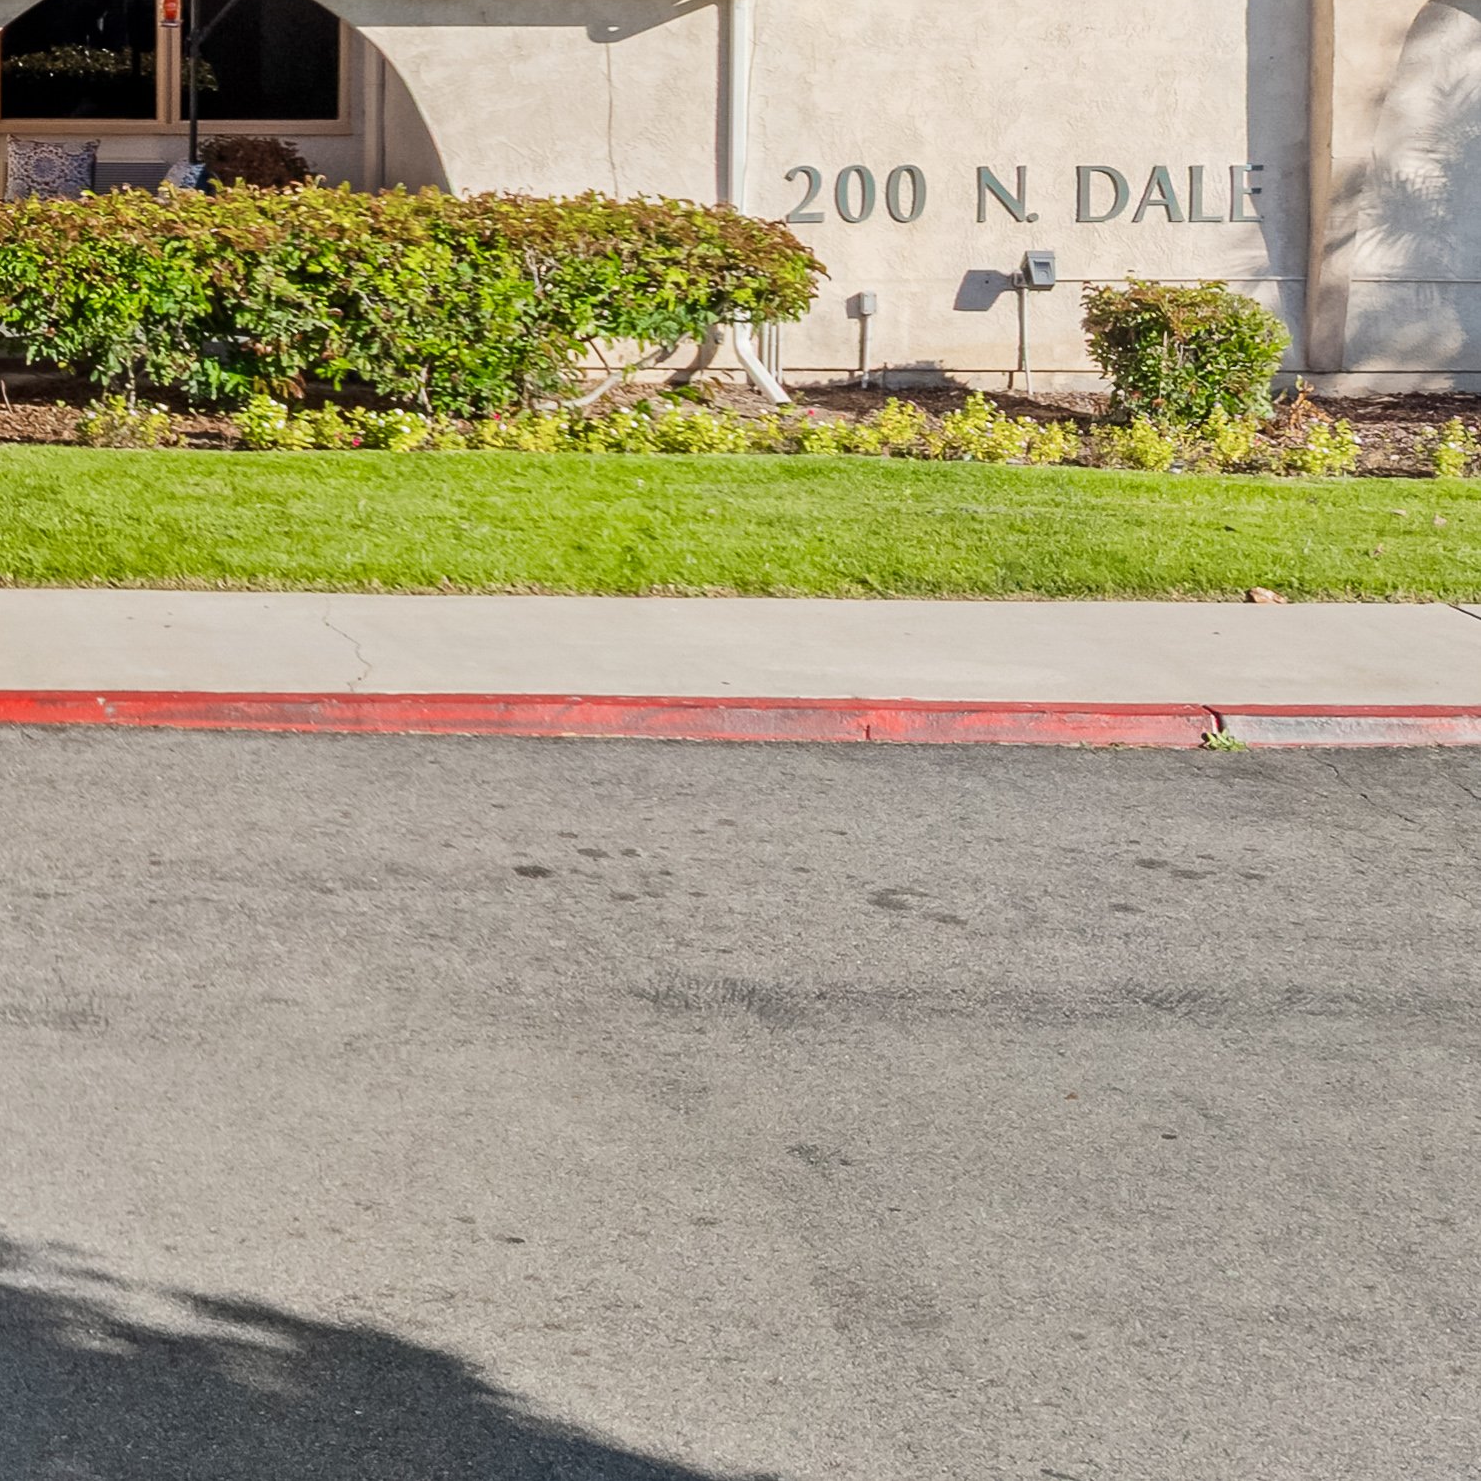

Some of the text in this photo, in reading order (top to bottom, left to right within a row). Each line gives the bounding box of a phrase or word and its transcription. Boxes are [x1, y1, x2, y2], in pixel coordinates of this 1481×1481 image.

[784, 165, 1265, 223] 200 N. DALE
